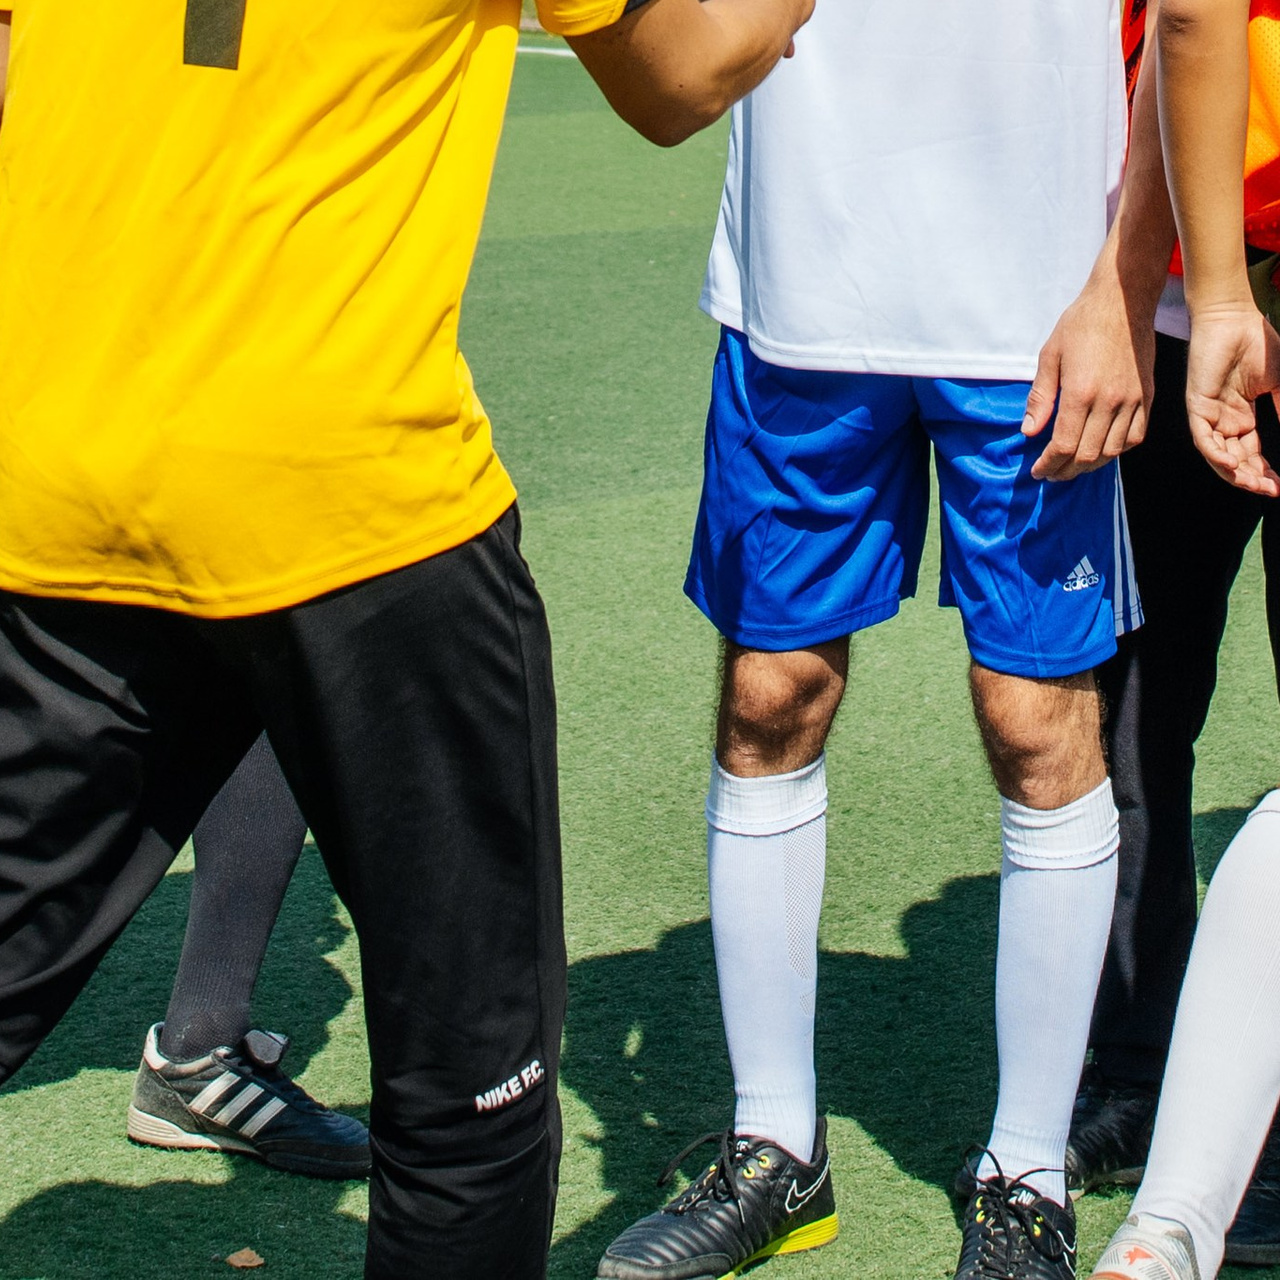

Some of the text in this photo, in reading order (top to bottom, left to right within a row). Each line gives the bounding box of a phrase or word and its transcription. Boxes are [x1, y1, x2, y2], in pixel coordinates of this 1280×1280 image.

[1063, 573, 1099, 591] adidas
[475, 1060, 544, 1112] NIKE F.C.
